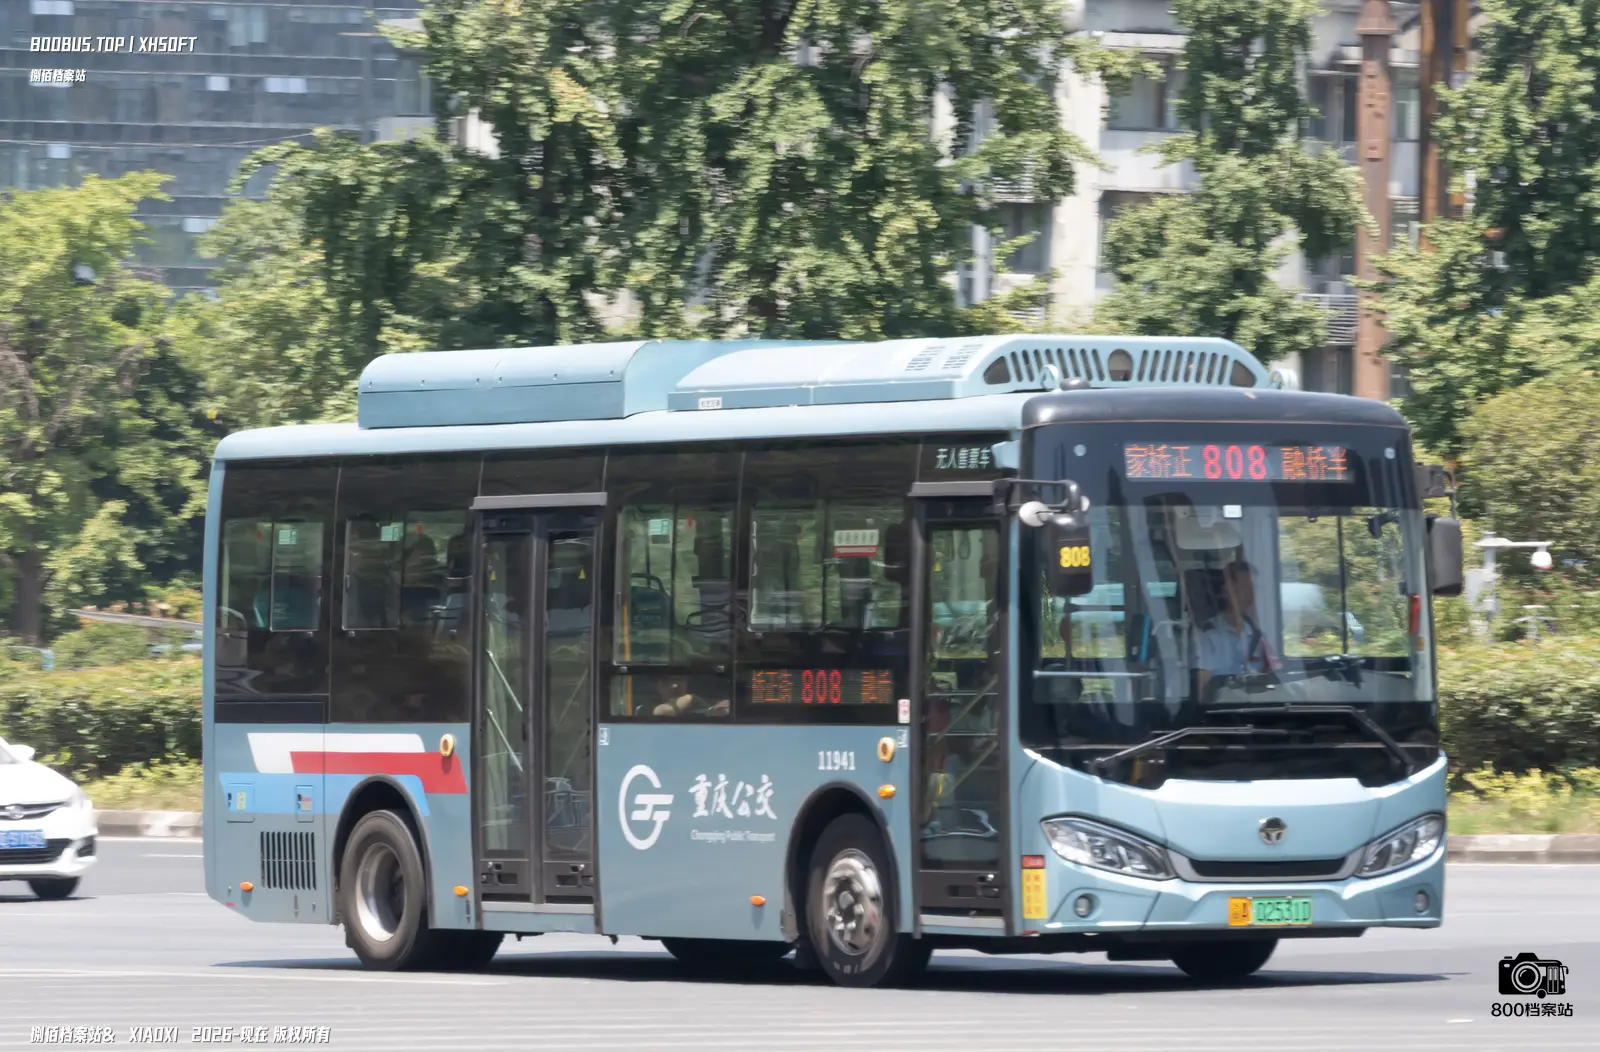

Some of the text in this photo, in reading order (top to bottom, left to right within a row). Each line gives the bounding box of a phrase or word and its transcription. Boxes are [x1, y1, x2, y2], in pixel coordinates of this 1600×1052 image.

[935, 447, 991, 469] 无人售票车
[1203, 444, 1266, 479] 808
[1060, 546, 1091, 567] 808
[801, 670, 842, 704] 808
[817, 750, 856, 771] 11941
[688, 773, 778, 820] 重庆公交
